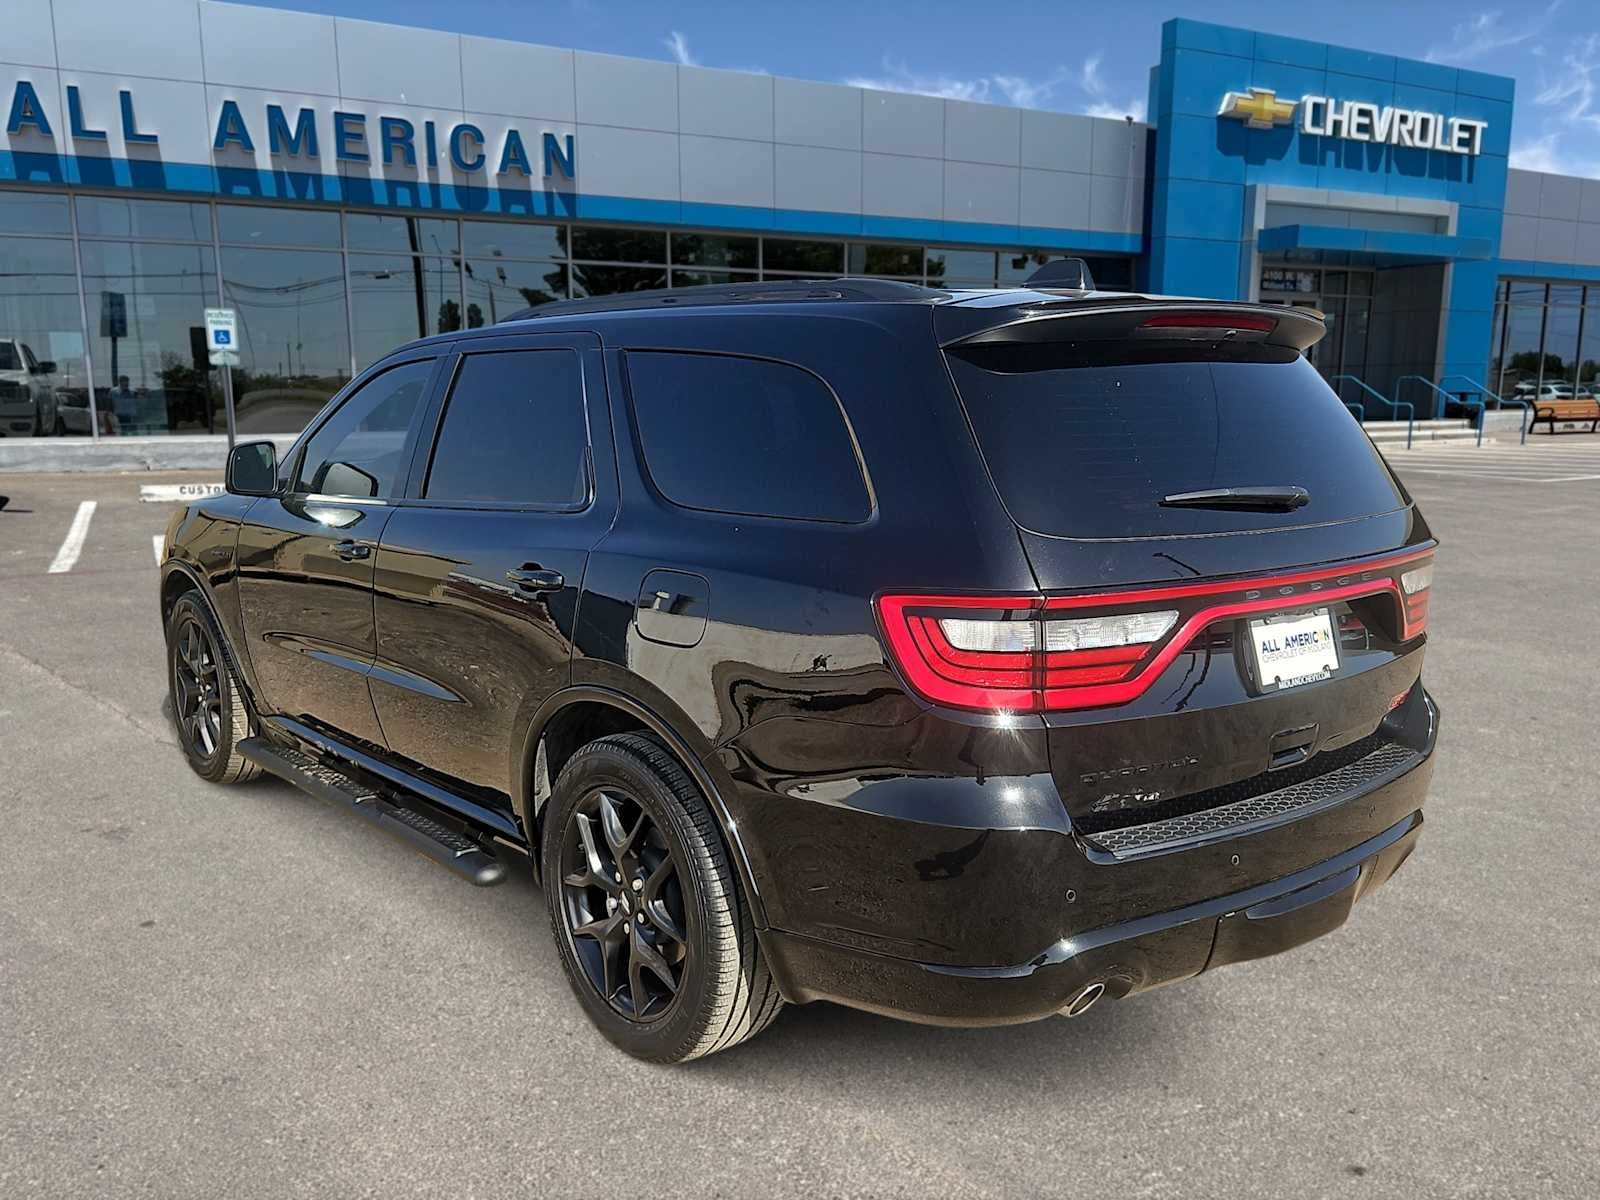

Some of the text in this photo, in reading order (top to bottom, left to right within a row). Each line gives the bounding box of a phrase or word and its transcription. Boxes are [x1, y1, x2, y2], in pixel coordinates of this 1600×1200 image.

[6, 80, 576, 179] ALL AMERICAN
[1301, 95, 1489, 156] CHEVROLET
[1245, 573, 1371, 600] DODGE
[1261, 639, 1281, 655] ALL
